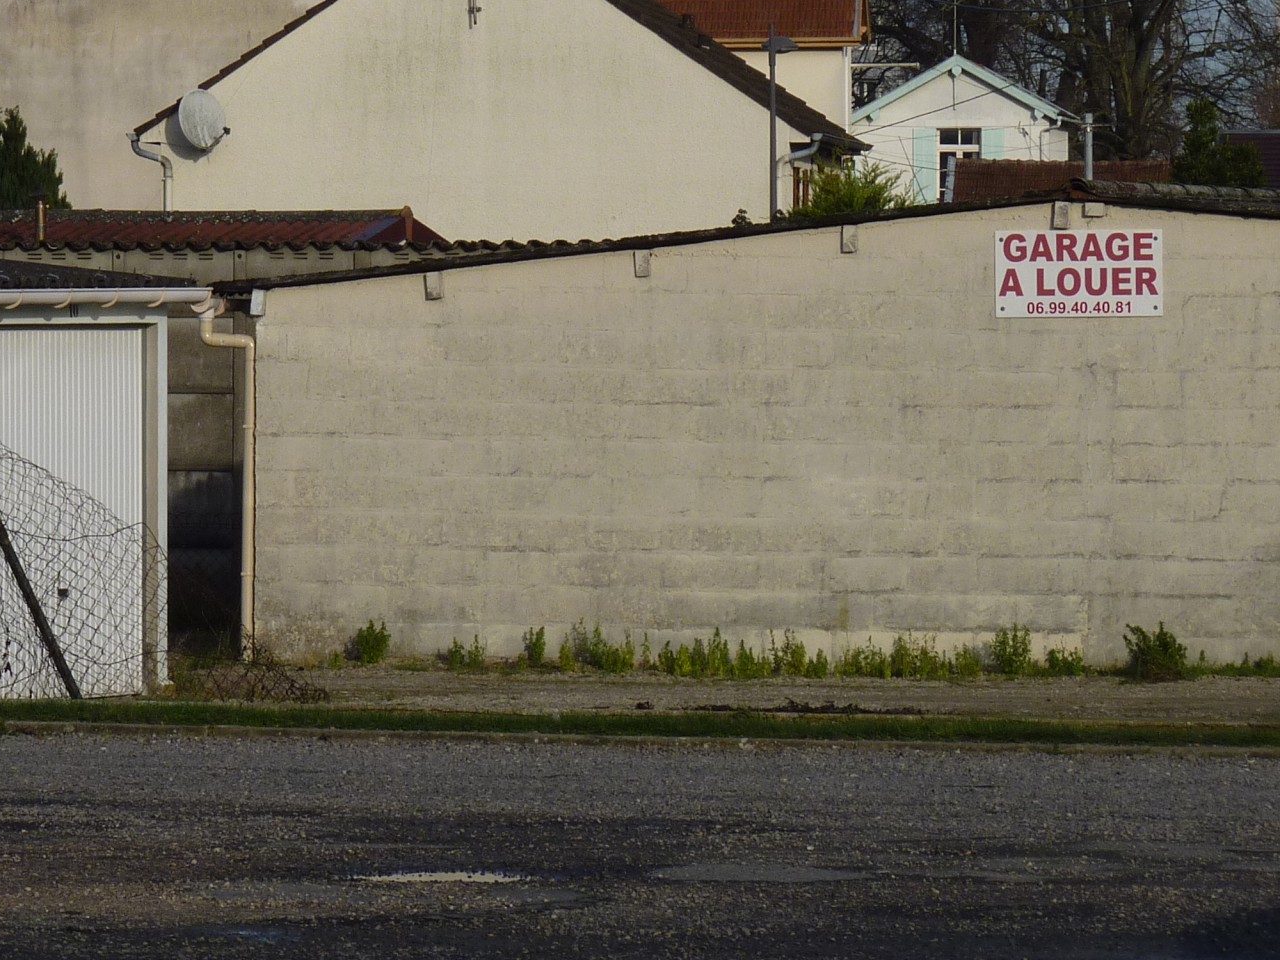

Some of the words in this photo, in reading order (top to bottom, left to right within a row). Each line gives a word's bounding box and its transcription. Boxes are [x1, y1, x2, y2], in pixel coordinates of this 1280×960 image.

[1003, 233, 1154, 262] GARAGE
[999, 268, 1024, 297] A
[1037, 267, 1159, 297] LOUER
[1027, 301, 1132, 314] 06.99.40.40.81
